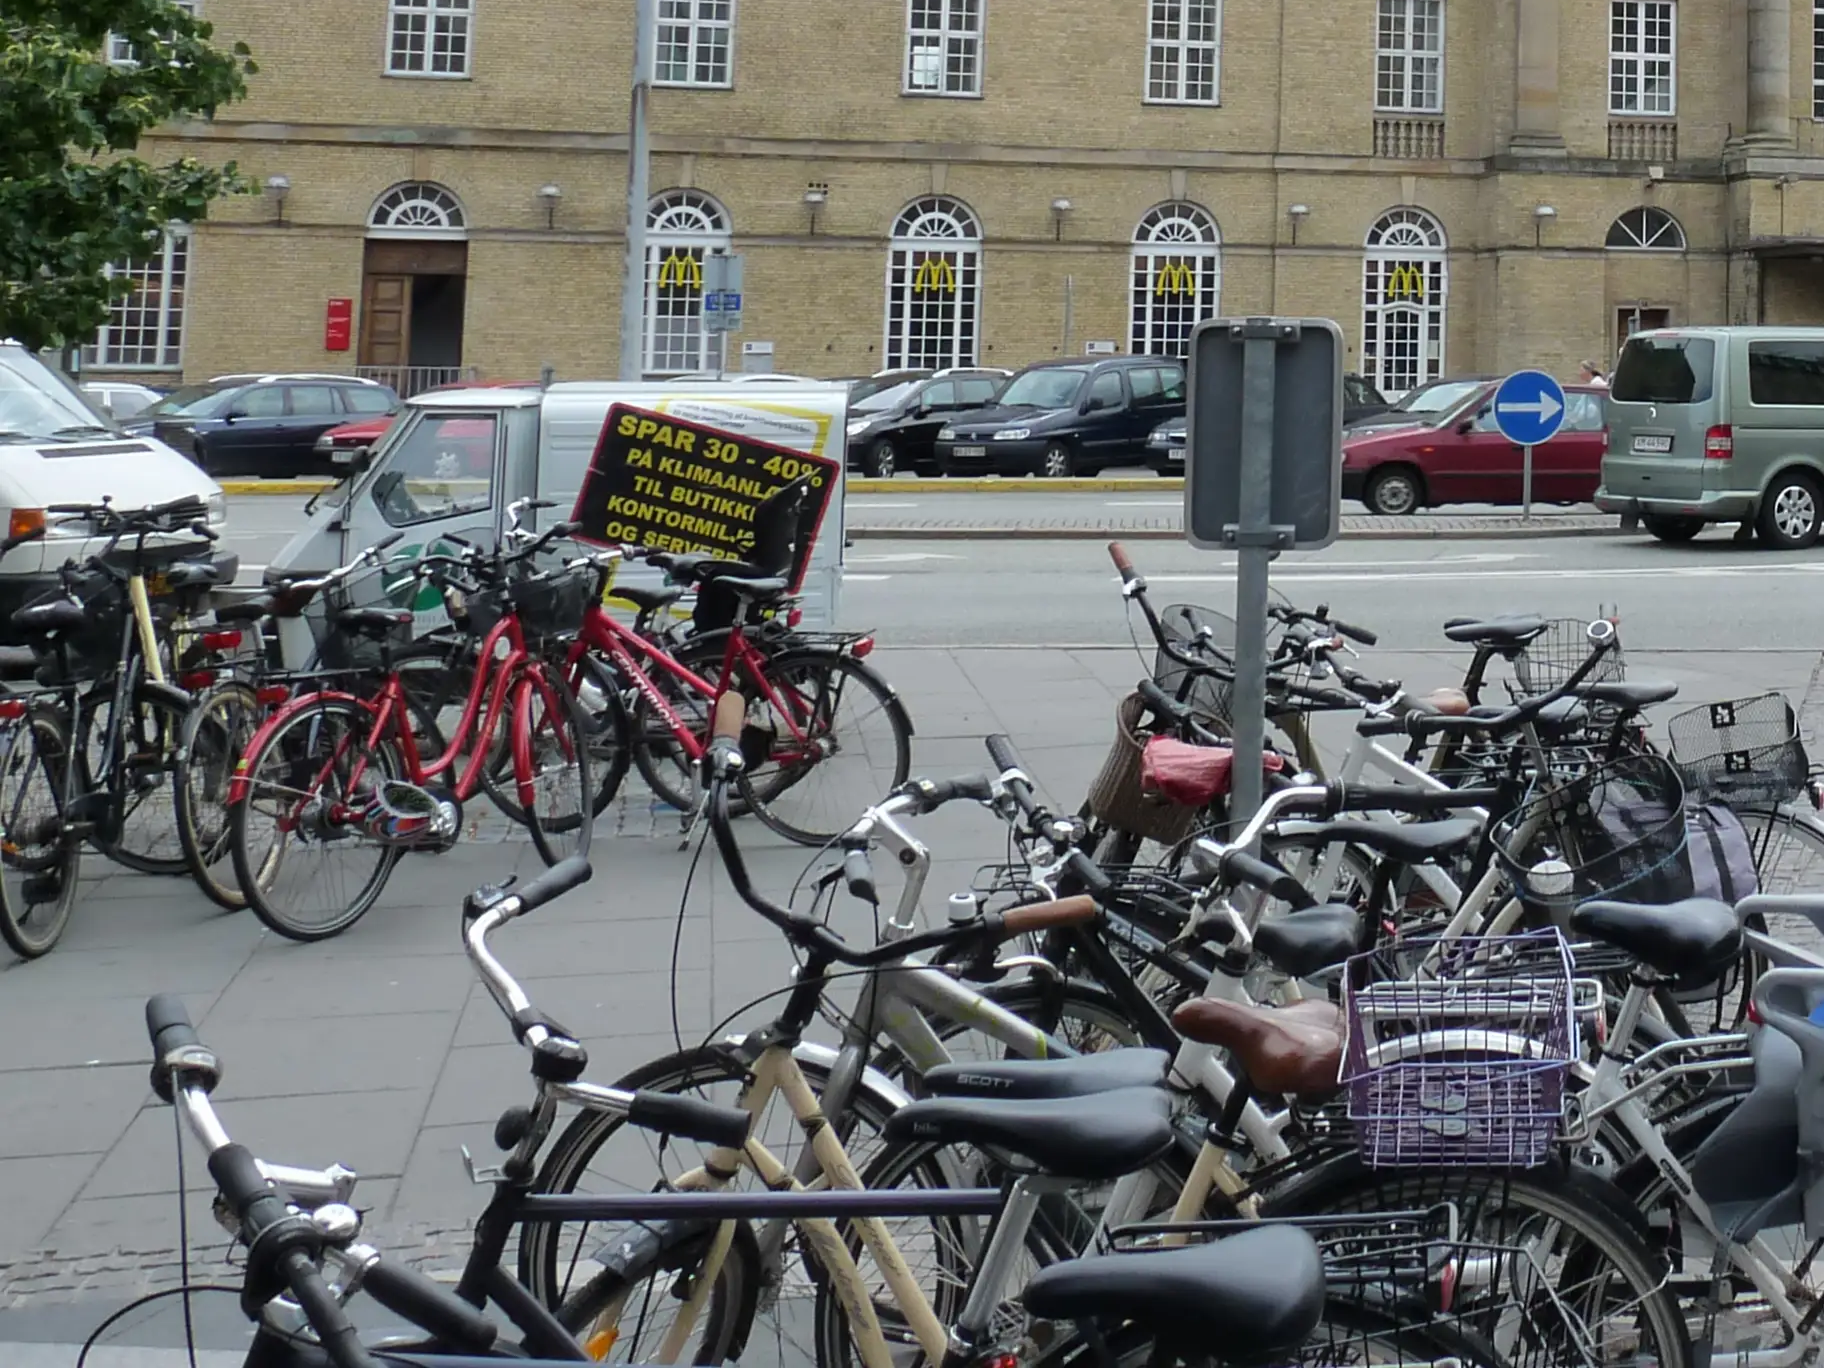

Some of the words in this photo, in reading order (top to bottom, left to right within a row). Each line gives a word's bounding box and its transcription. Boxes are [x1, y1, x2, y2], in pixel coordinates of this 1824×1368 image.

[617, 415, 696, 452] SPAR
[702, 438, 739, 464] 30
[762, 455, 823, 488] 40%
[626, 447, 652, 469] PÅ
[634, 475, 665, 498] TIL
[606, 521, 638, 542] OG
[611, 649, 680, 730] CENTURION
[957, 1073, 1015, 1088] SCOTT
